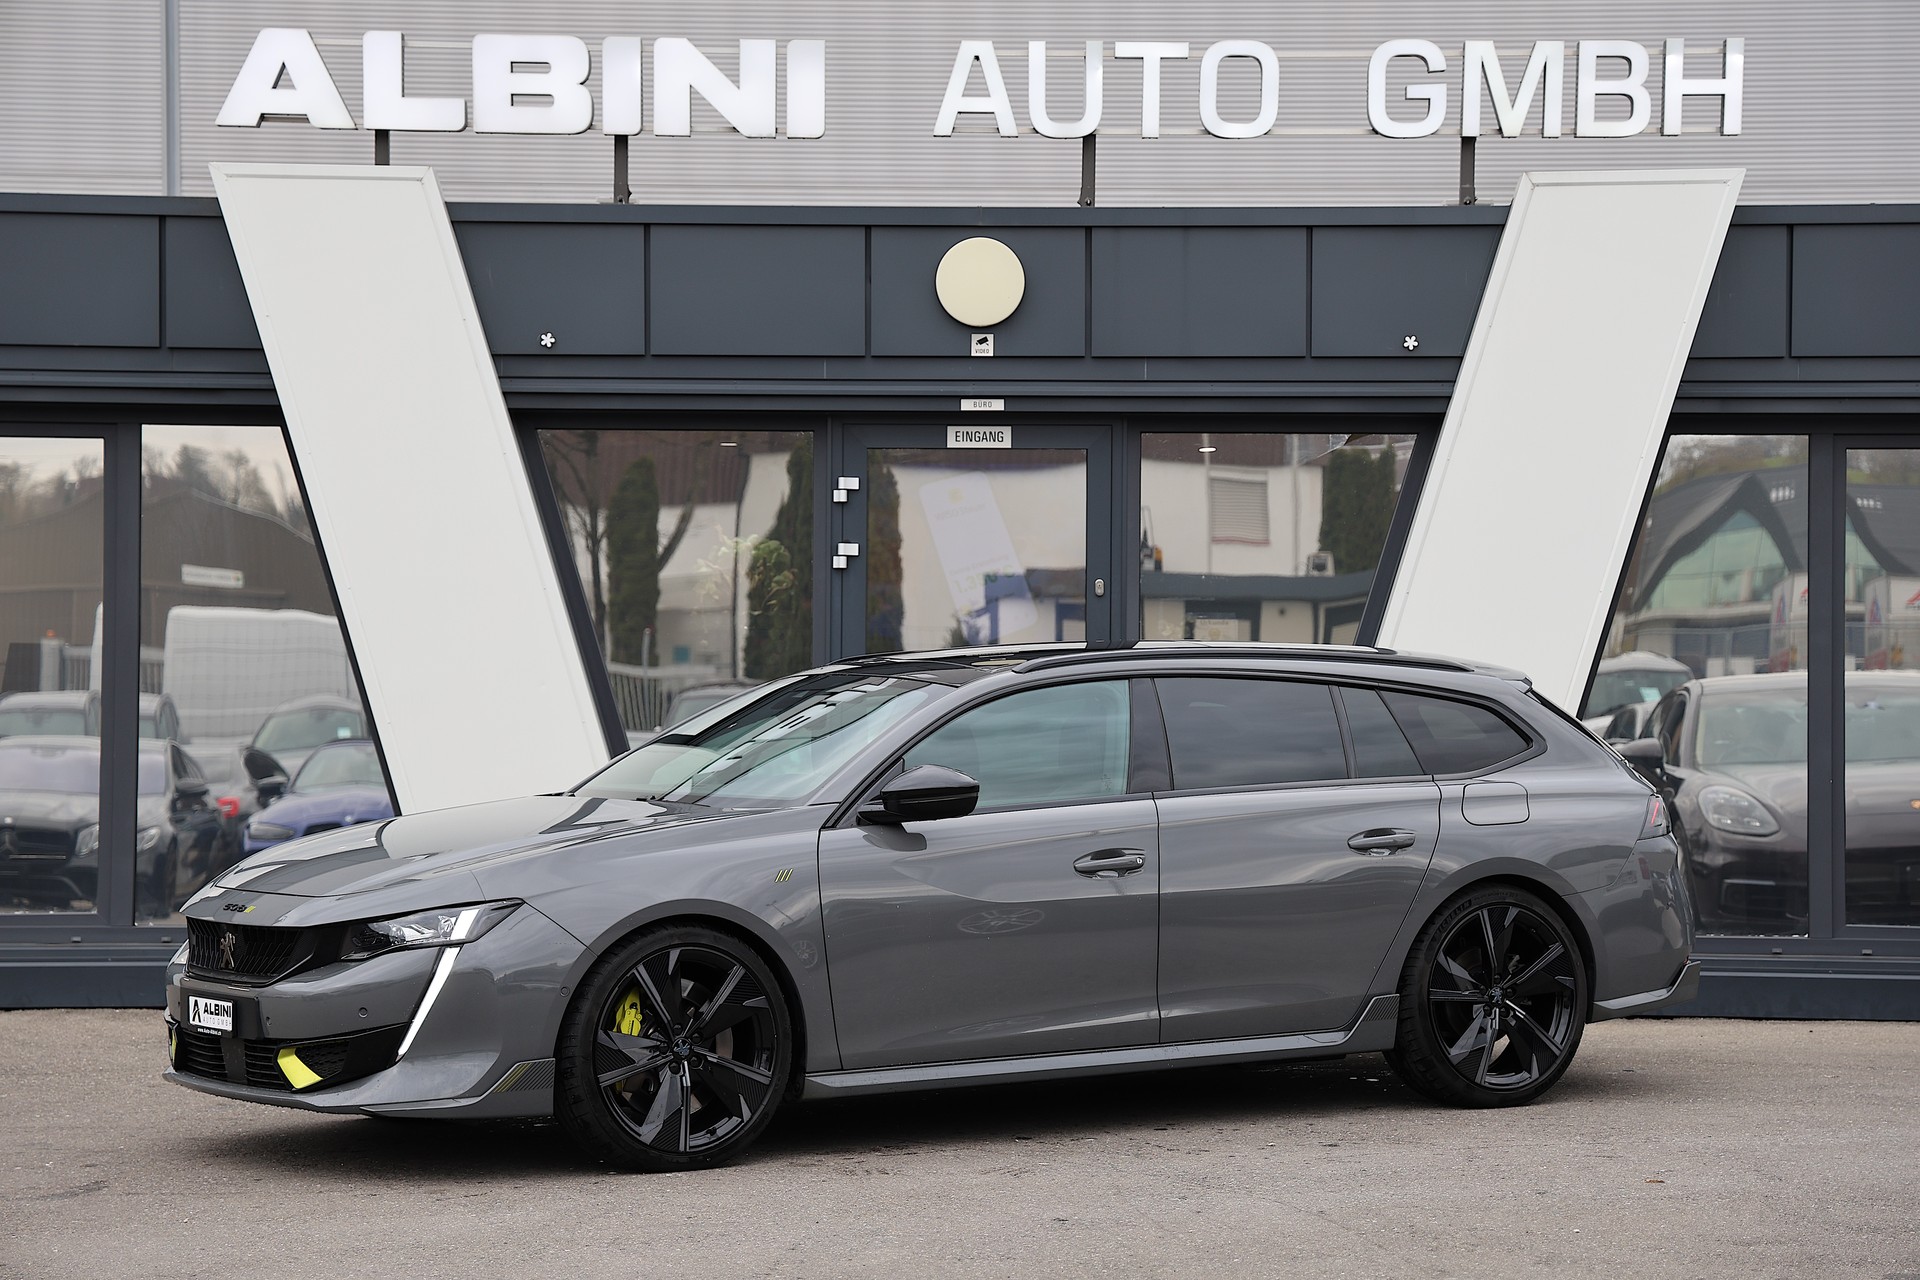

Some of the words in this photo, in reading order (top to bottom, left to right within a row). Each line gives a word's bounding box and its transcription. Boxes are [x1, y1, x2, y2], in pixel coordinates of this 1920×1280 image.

[215, 27, 827, 139] ALBINI
[933, 38, 1280, 140] AUTO
[1366, 37, 1745, 140] GMBH
[954, 430, 1004, 443] EINGANG
[203, 1002, 232, 1018] ALBINI
[203, 1016, 216, 1025] AUTO
